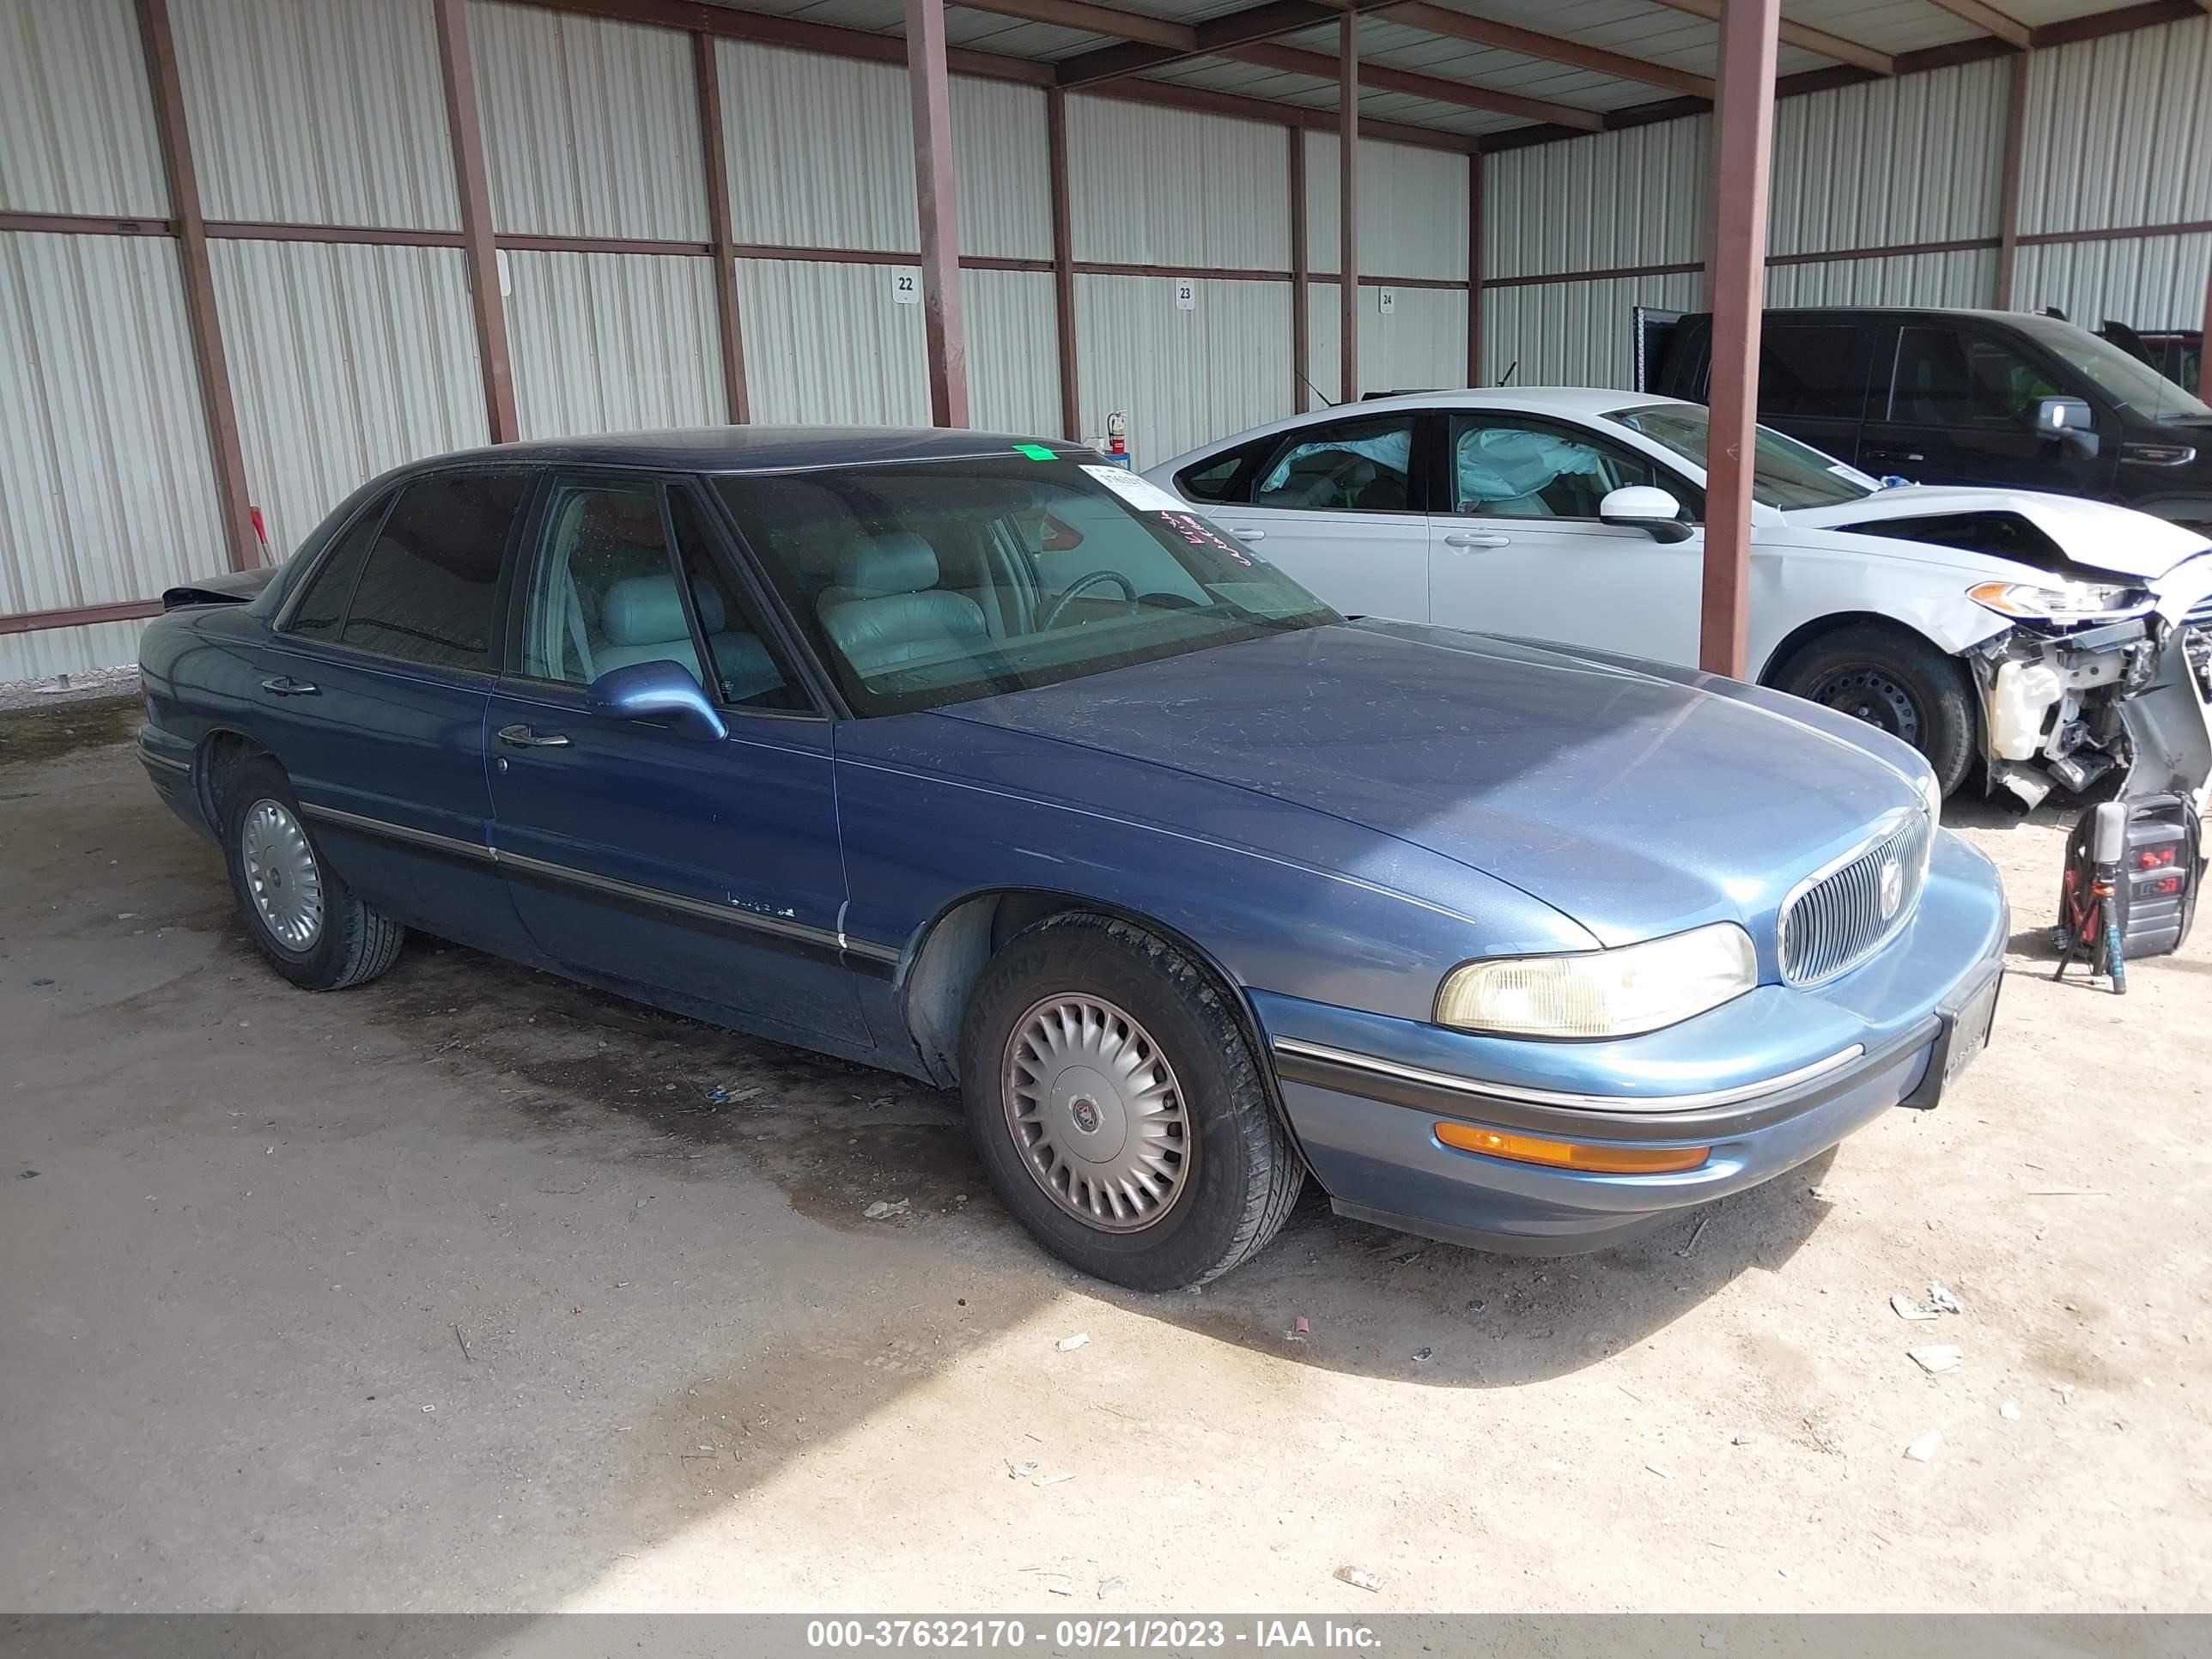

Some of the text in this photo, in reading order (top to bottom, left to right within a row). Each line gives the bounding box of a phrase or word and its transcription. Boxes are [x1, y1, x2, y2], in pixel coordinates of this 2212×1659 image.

[898, 276, 914, 291] 22
[1180, 287, 1191, 300] 23
[1383, 295, 1392, 305] 24
